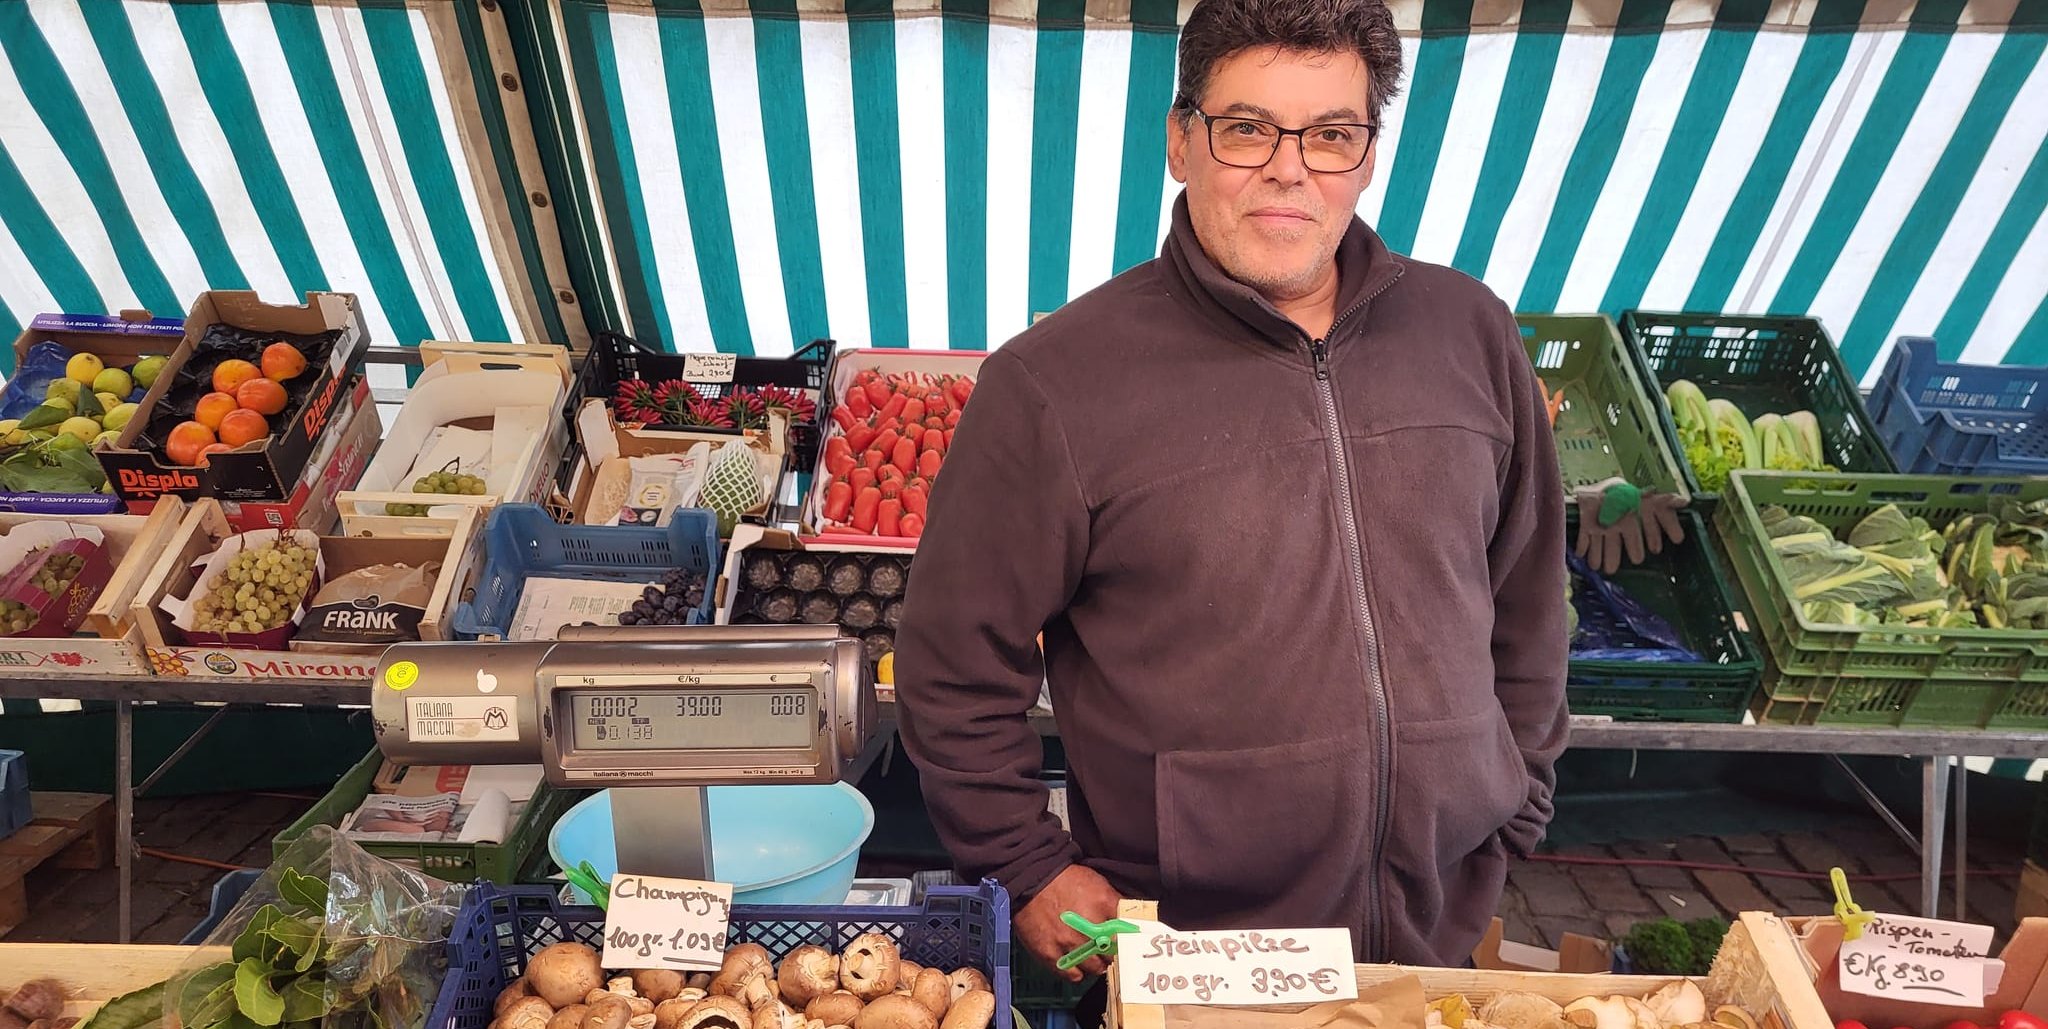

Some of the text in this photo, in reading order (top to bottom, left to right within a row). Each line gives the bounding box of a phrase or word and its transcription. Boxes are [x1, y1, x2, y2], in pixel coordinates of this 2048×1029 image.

[582, 676, 595, 685] kg
[677, 675, 701, 685] €/kg
[416, 702, 453, 717] ITALIANA
[591, 696, 806, 717] 0.002 39.00 0.08
[417, 721, 455, 736] MACCHI
[609, 725, 653, 740] 0.138
[1142, 931, 1310, 961] Steinpilze
